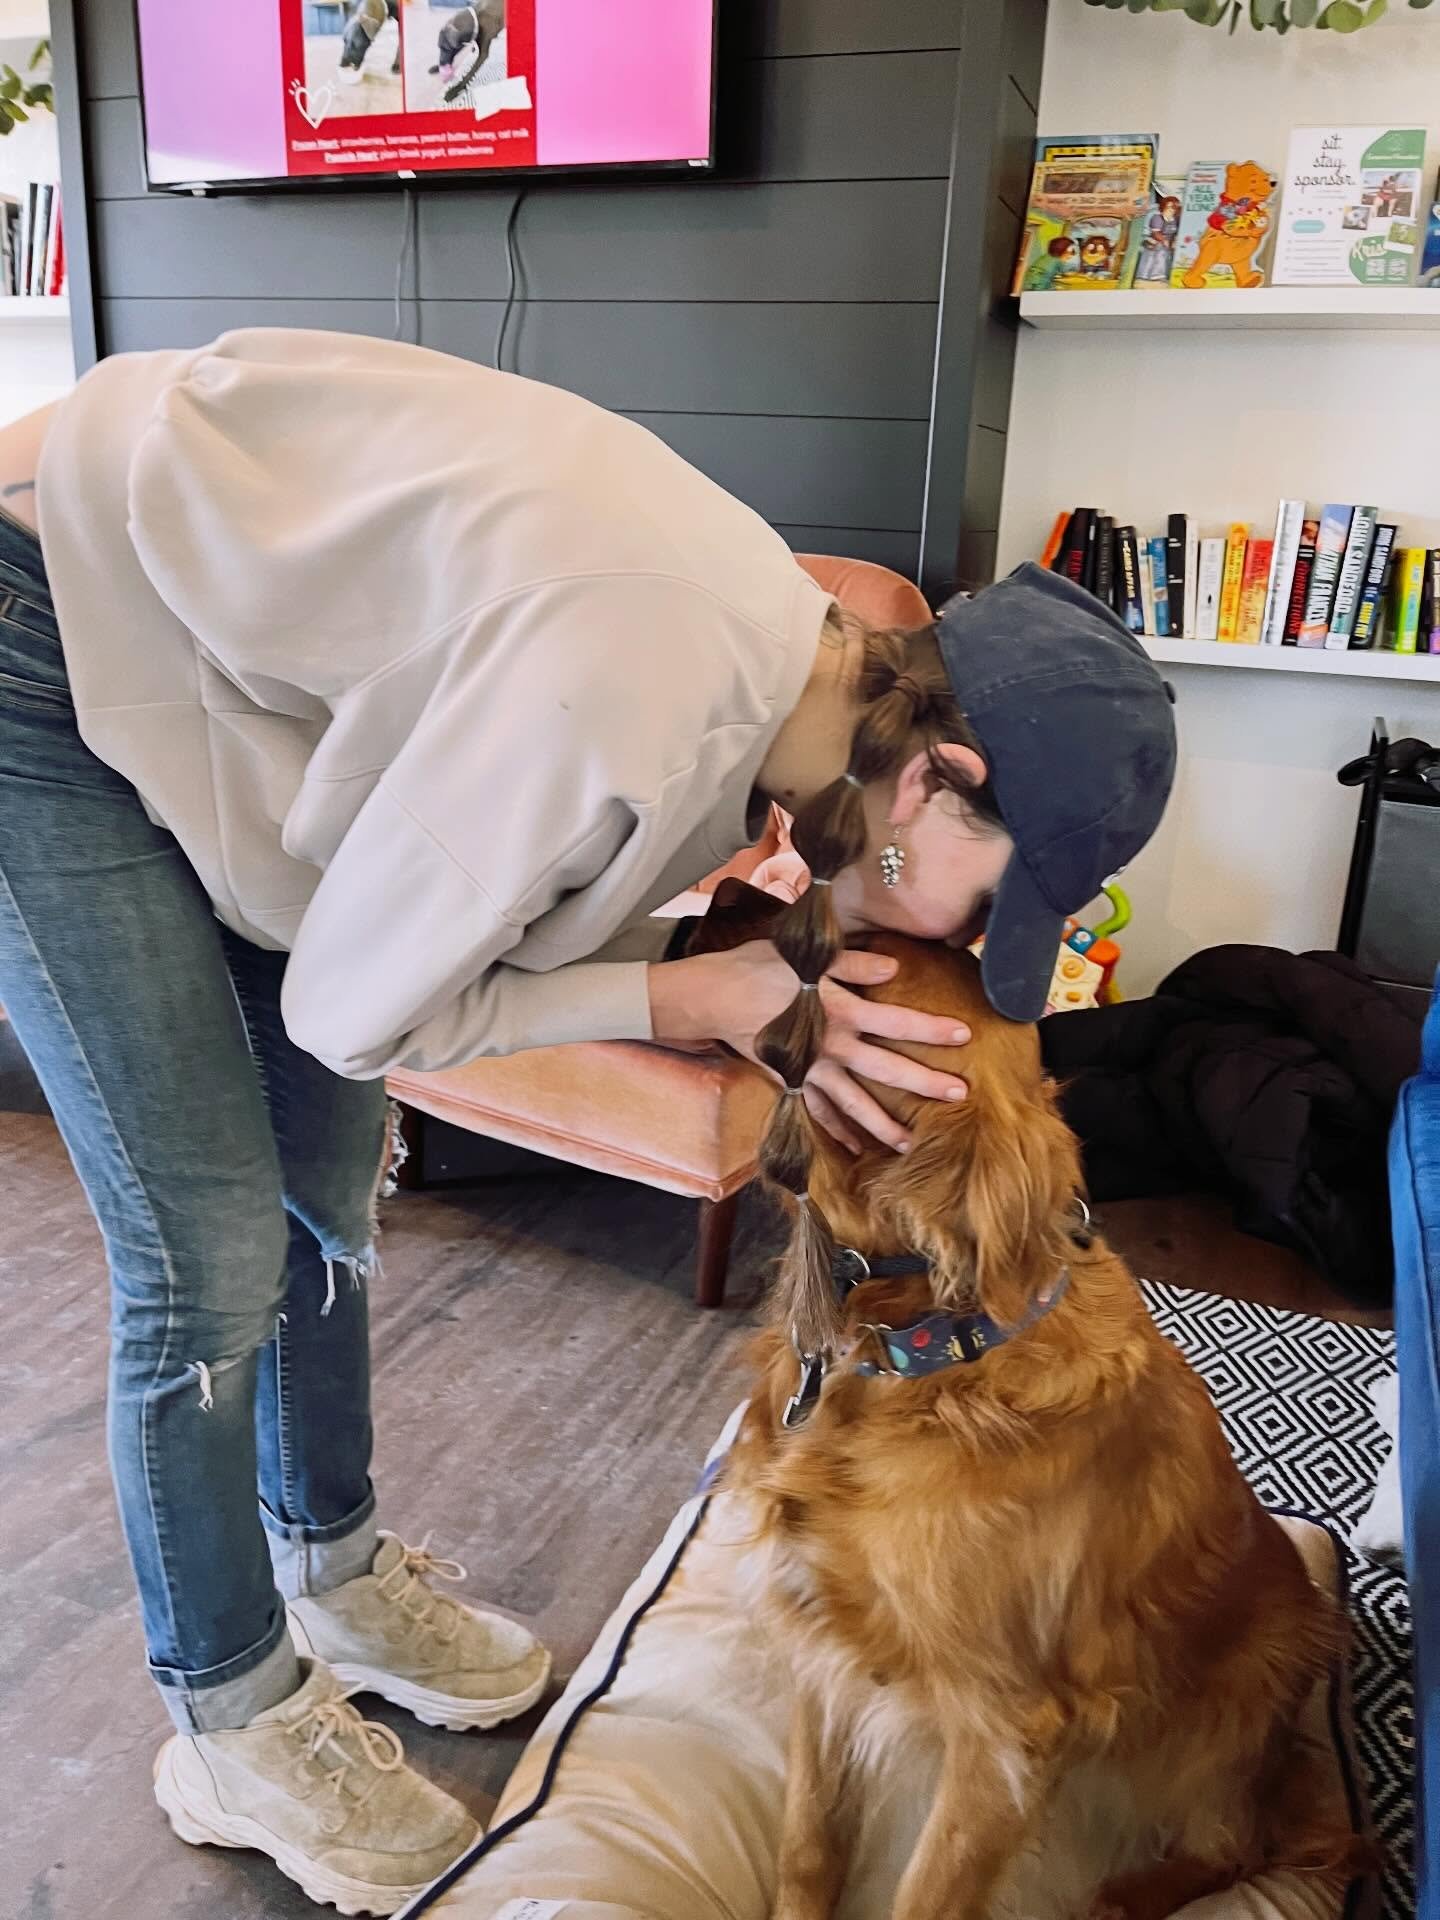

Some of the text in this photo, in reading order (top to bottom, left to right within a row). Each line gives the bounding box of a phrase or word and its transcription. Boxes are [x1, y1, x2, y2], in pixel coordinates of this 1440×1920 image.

[1334, 515, 1370, 614] JOHN SANDFORD
[1368, 527, 1393, 584] JOHN SANDFORD
[1288, 559, 1309, 633] CORRECTIONS
[1305, 581, 1332, 625] FRANZEN
